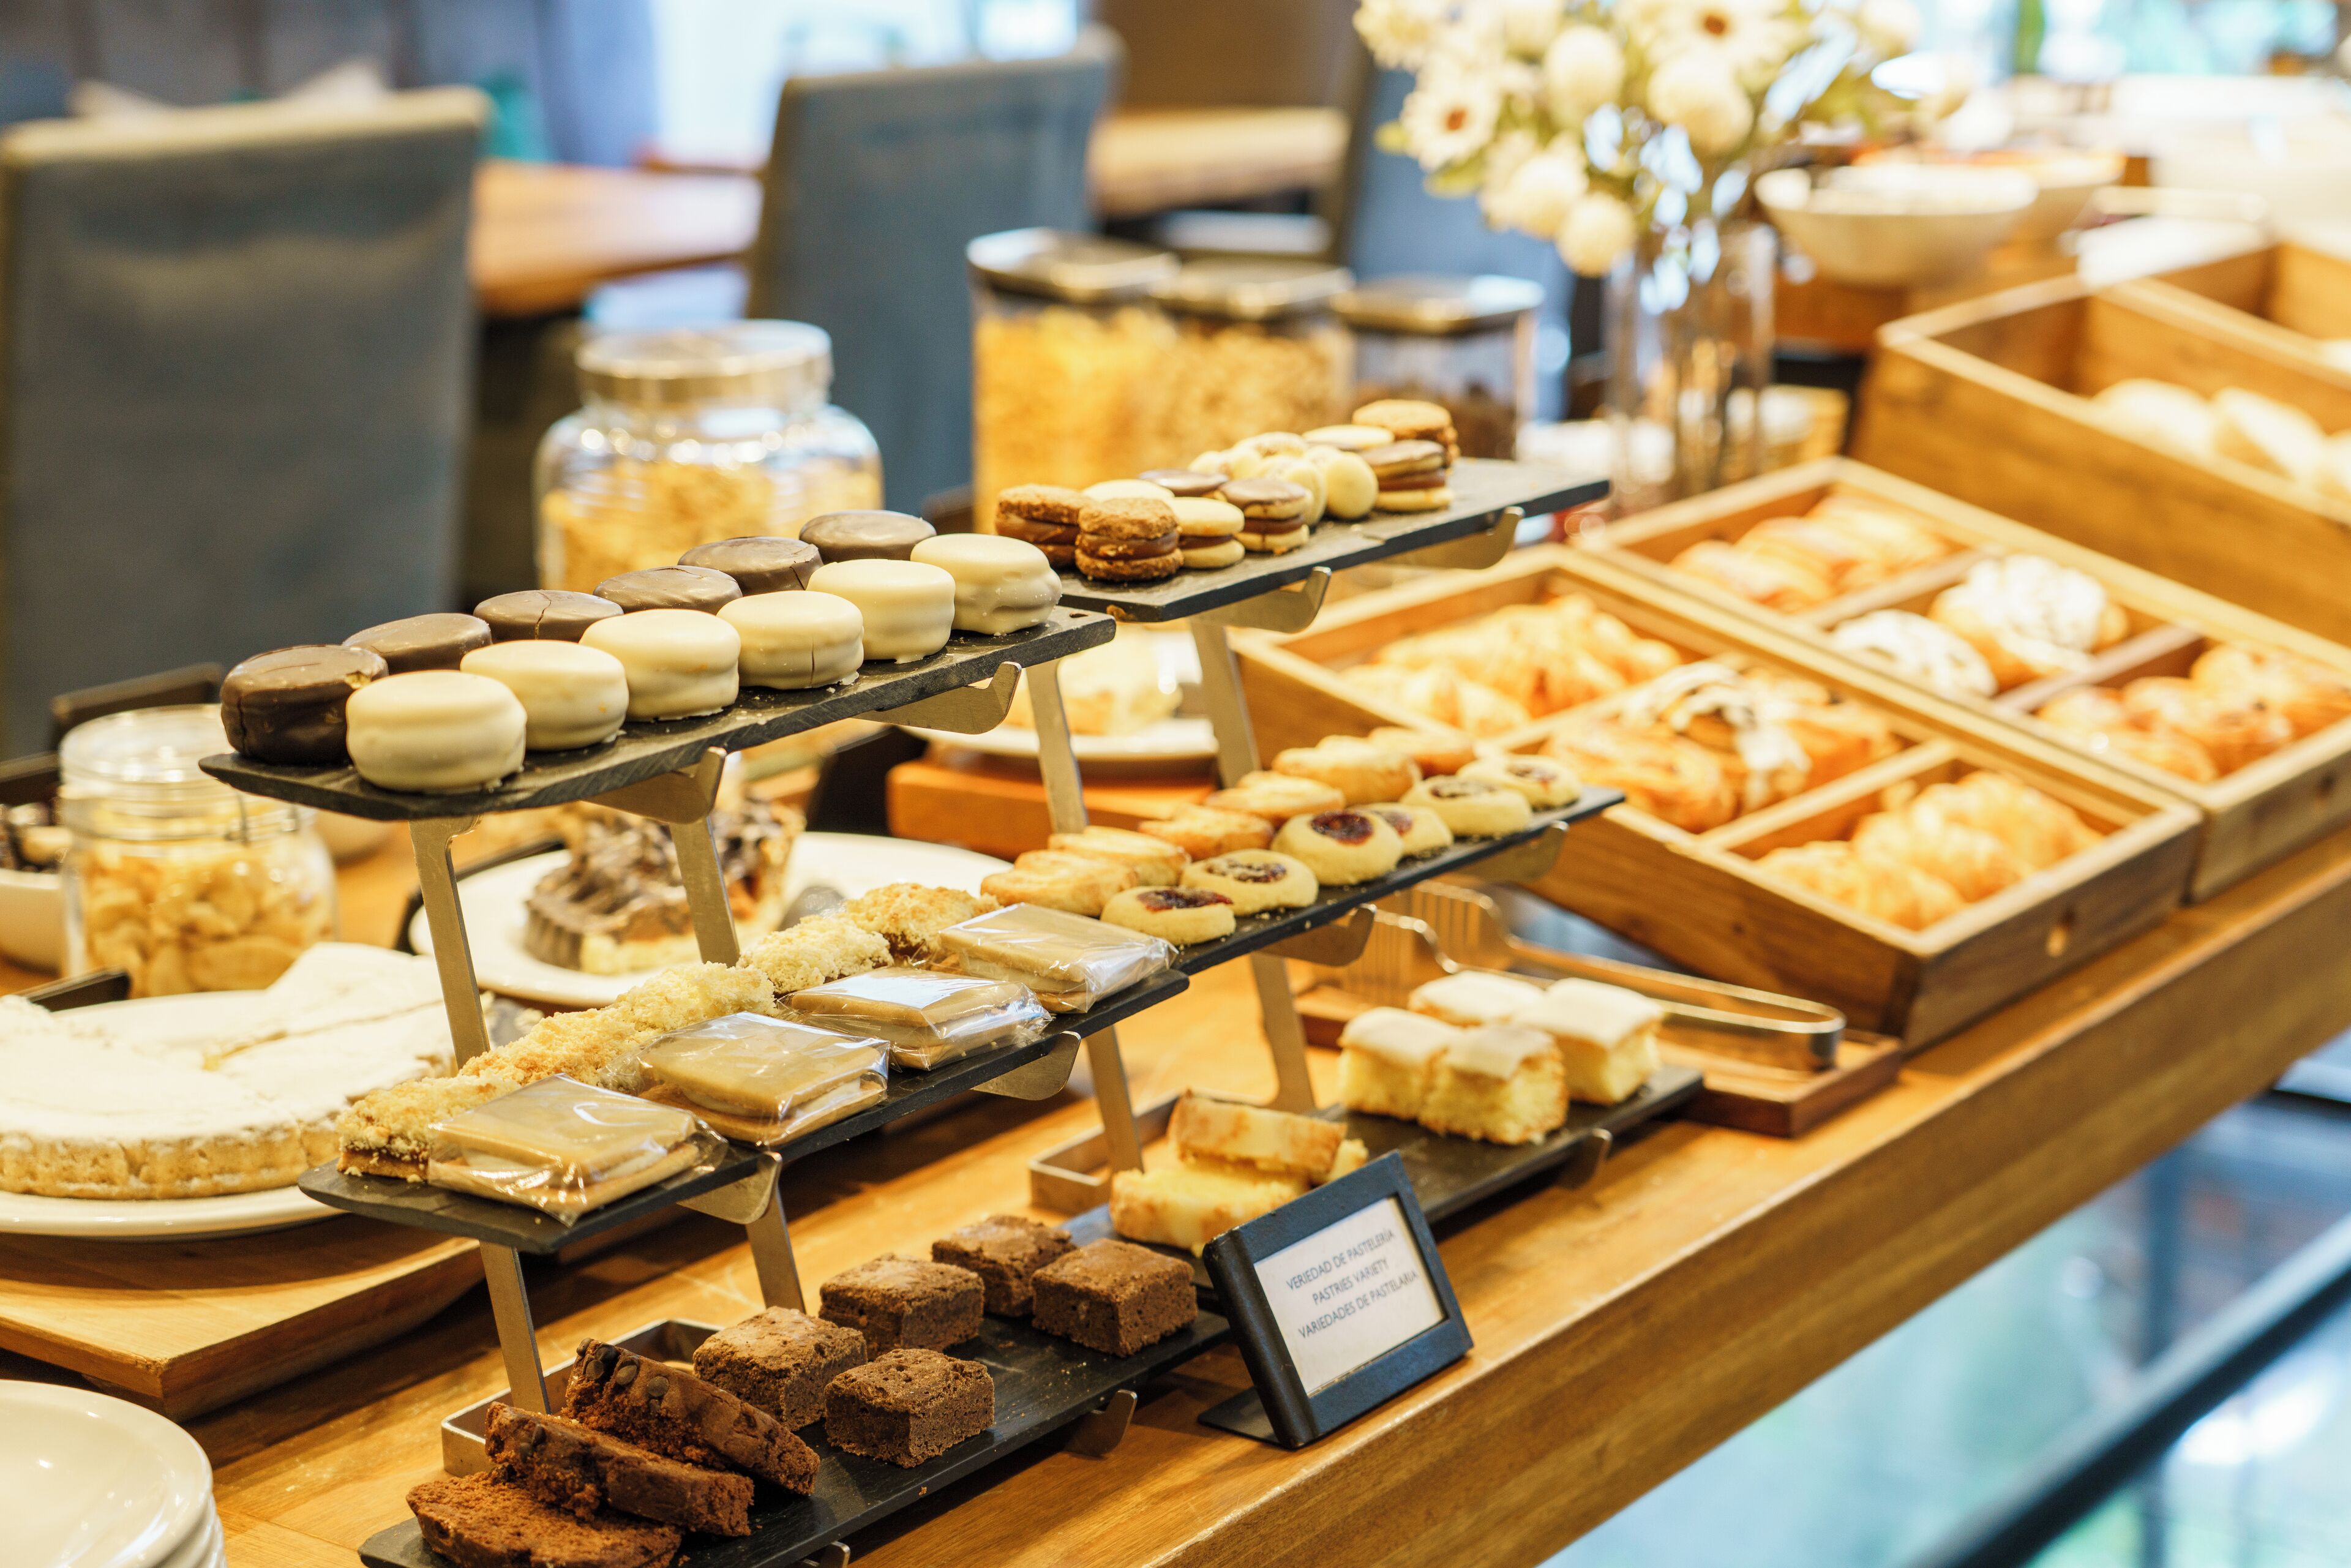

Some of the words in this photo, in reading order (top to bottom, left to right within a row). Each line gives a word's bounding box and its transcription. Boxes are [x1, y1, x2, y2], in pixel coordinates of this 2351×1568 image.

[1312, 1276, 1354, 1305] PASTRIES
[1354, 1258, 1389, 1283] VARIETY
[1333, 1253, 1346, 1269] DE
[1298, 1302, 1355, 1338] VARIEDADES
[1356, 1294, 1370, 1310] DE
